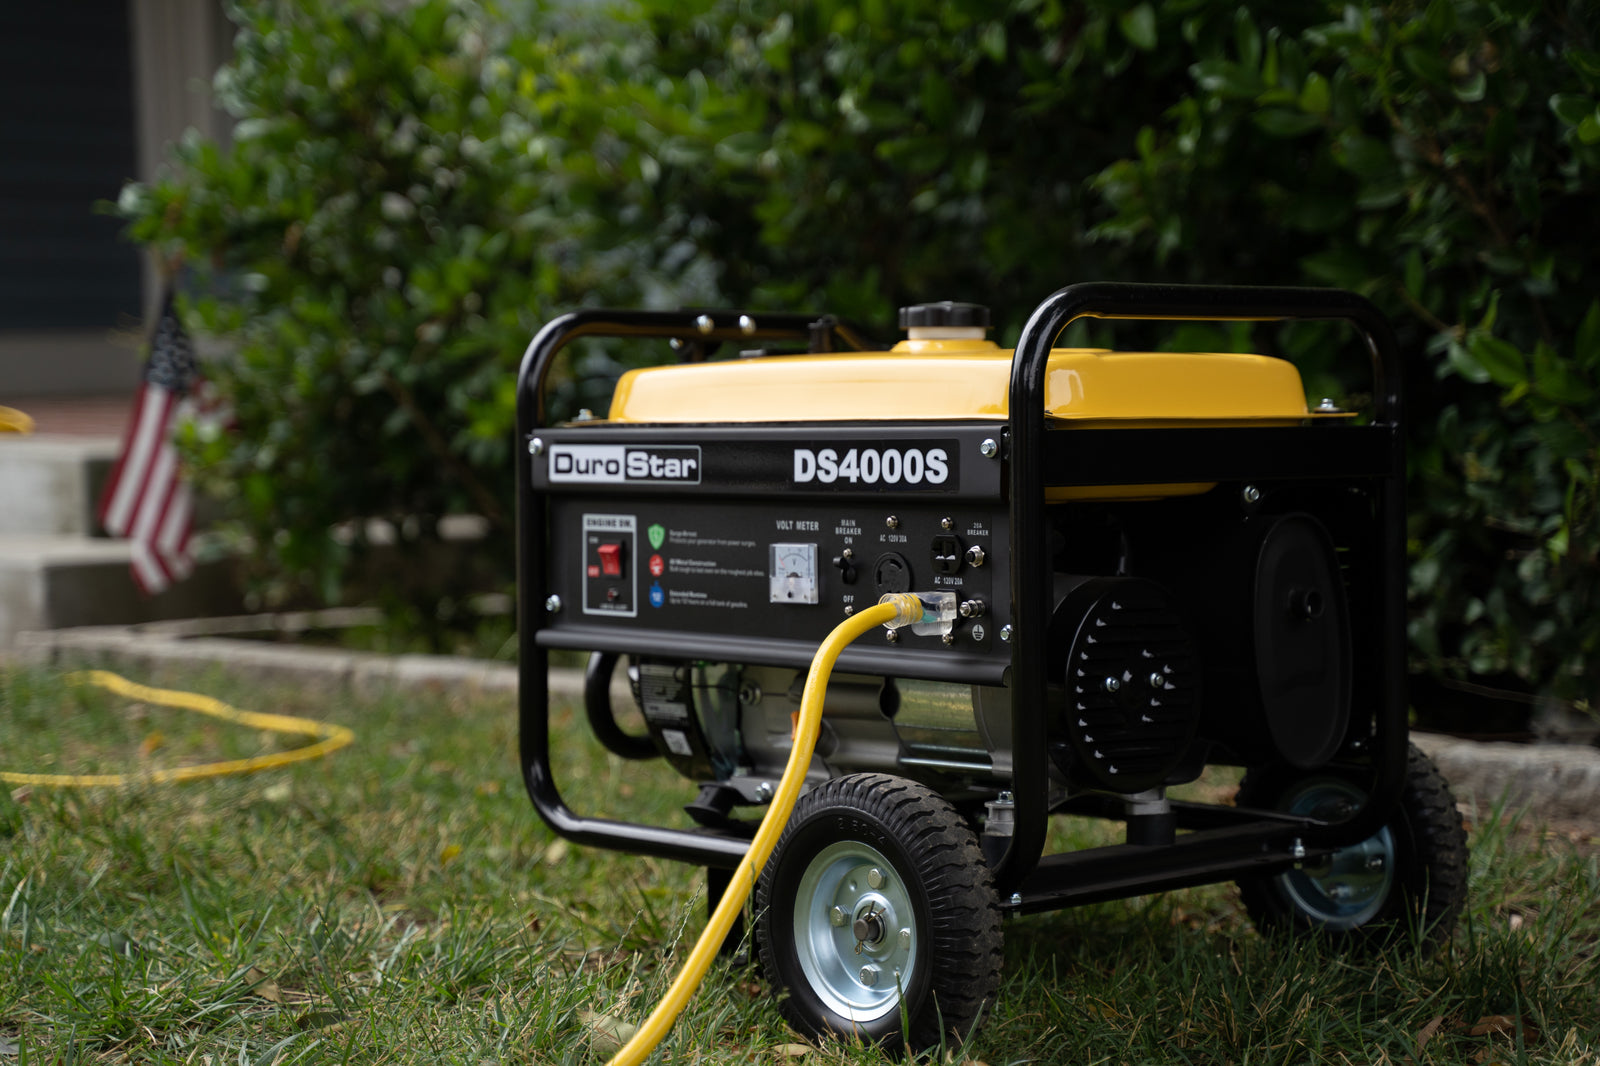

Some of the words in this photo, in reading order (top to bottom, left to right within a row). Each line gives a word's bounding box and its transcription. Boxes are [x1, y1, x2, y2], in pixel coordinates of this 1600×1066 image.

[793, 448, 949, 484] DS4000S
[587, 518, 617, 528] ENGINE
[776, 520, 793, 530] VOLT
[796, 520, 819, 531] METER
[841, 519, 856, 527] MAIN
[835, 527, 862, 536] BREAKER
[844, 536, 853, 545] ON
[880, 534, 886, 542] AC
[934, 576, 941, 585] AC
[843, 595, 854, 603] OFF
